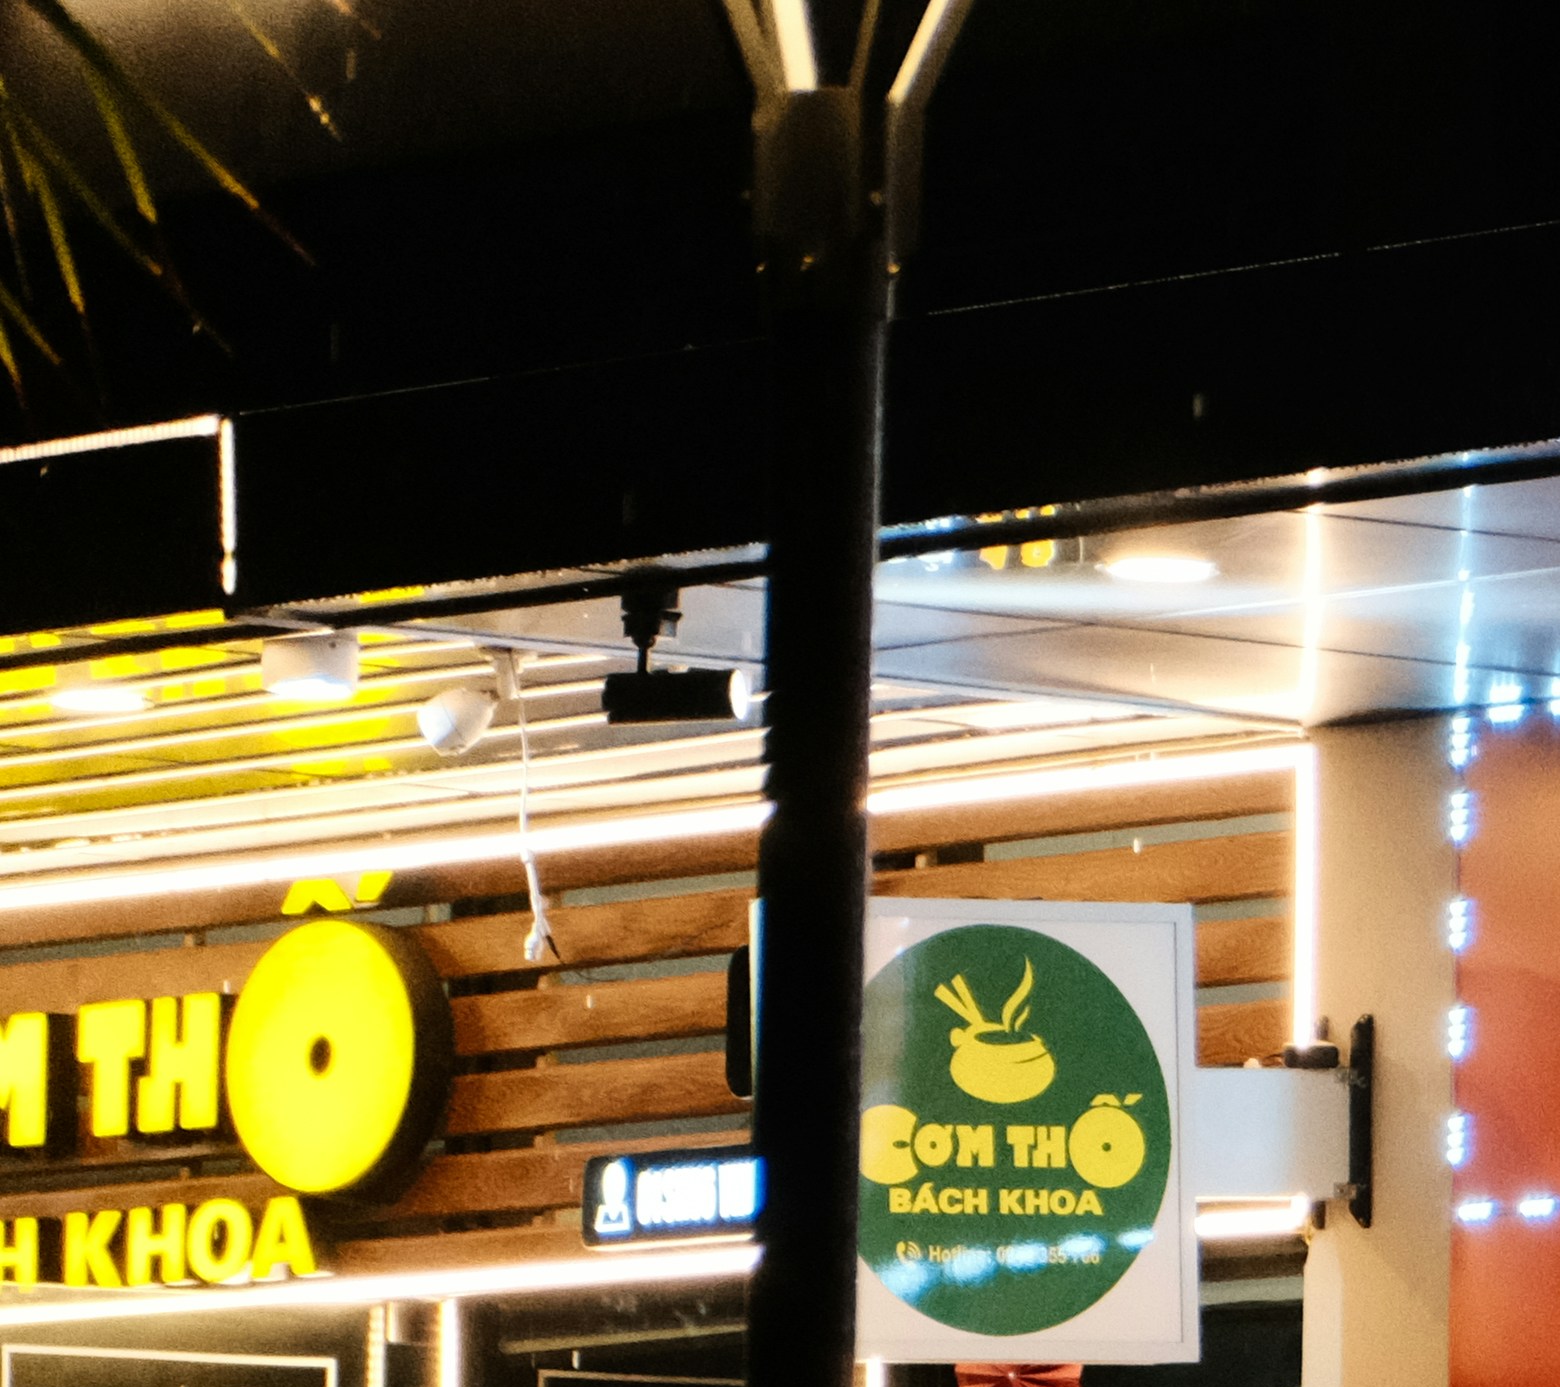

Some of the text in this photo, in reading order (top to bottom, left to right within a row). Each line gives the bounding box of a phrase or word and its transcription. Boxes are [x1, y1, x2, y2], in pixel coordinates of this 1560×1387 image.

[77, 870, 416, 1193] THỐ
[860, 1094, 1146, 1189] CƠM THỐ
[65, 1196, 317, 1288] KHOA
[889, 1182, 1104, 1216] BÁCH KHOA
